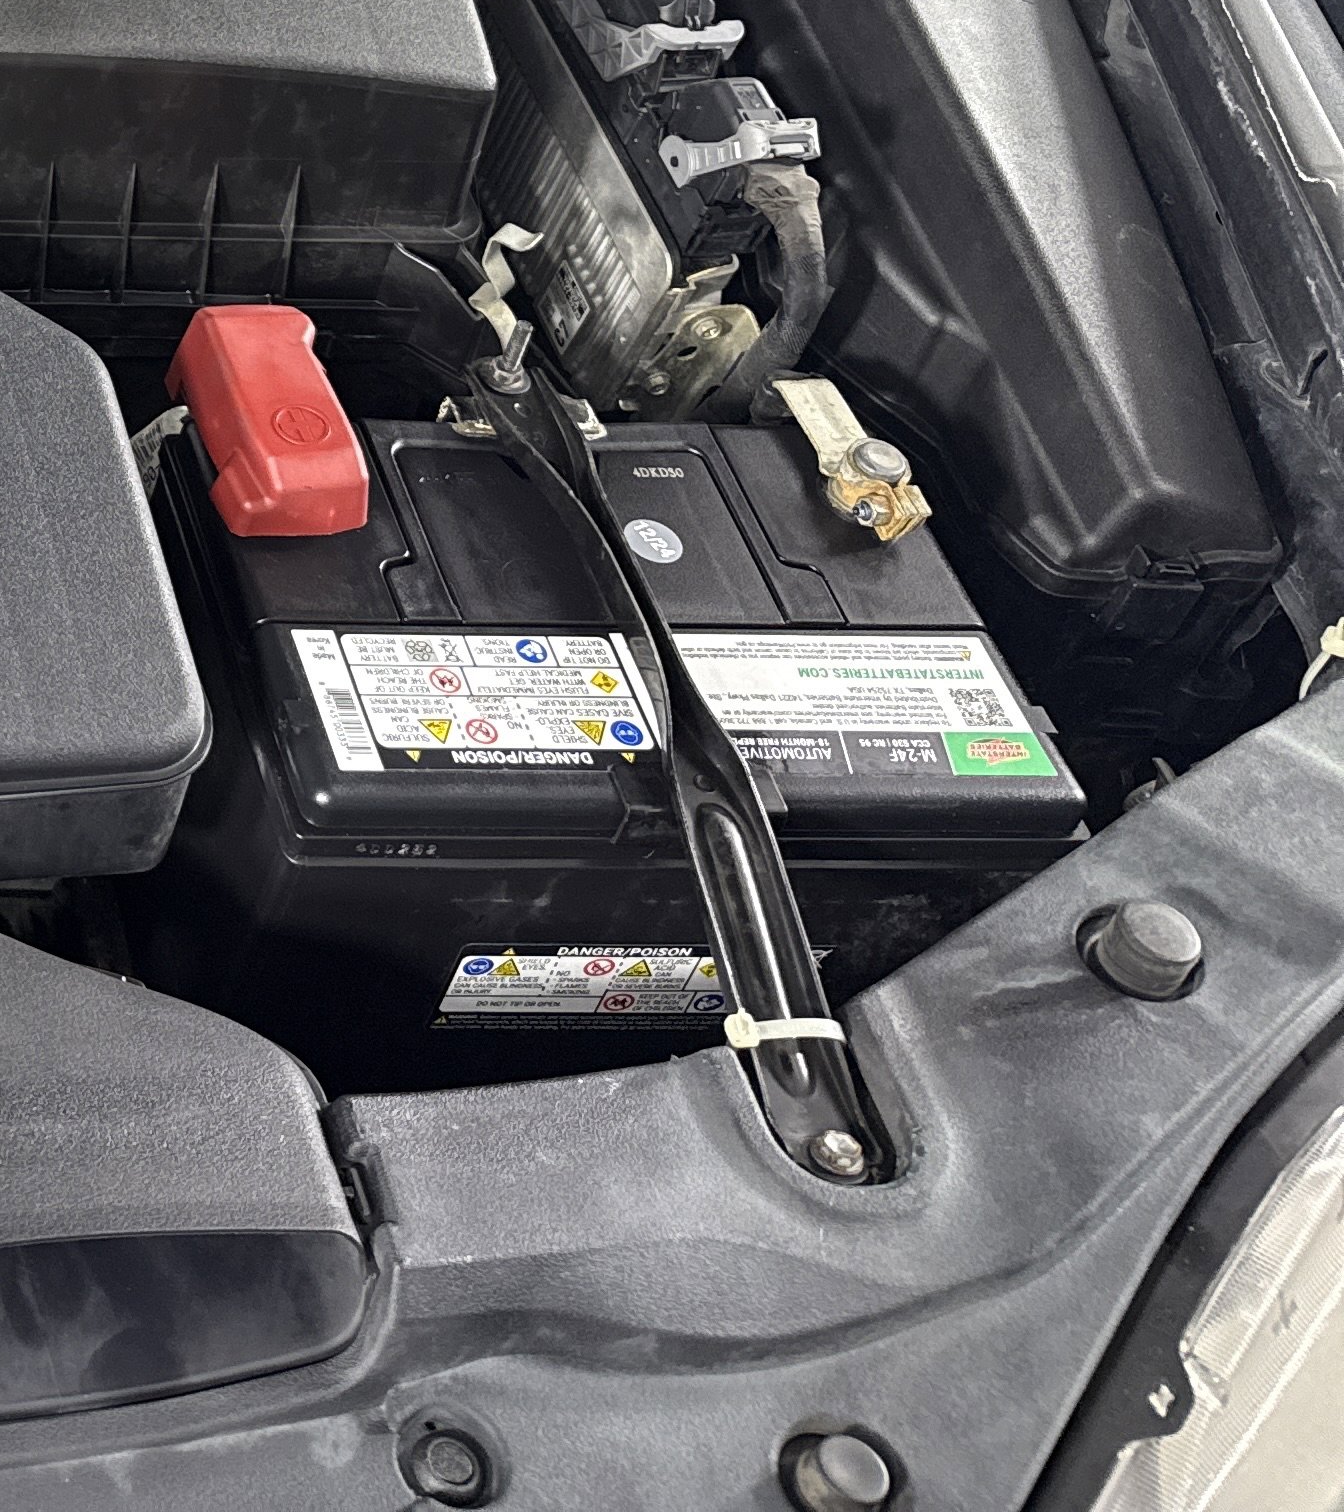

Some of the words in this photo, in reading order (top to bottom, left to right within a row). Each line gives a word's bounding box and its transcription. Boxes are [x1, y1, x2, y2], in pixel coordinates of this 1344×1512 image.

[633, 520, 676, 559] 12/24
[356, 645, 369, 653] BE
[370, 645, 395, 653] MUST
[567, 648, 592, 656] OPEN
[593, 648, 607, 656] OR
[311, 652, 336, 661] Made
[360, 654, 399, 663] BATTERY
[563, 656, 576, 664] TIP
[577, 656, 596, 664] NOT
[597, 656, 611, 664] DO
[517, 668, 542, 677] HELP
[543, 668, 583, 677] MEDICAL
[797, 667, 986, 680] INTERSTATEBATTERIES.COM
[376, 676, 408, 685] REACH
[409, 676, 428, 685] THE
[507, 677, 525, 686] GET
[560, 677, 586, 686] WITH
[388, 685, 406, 694] OUT
[408, 685, 430, 694] KEEP
[535, 686, 559, 695] EYES
[560, 686, 590, 695] FLUSH
[422, 707, 450, 715] CAUSE
[474, 704, 510, 712] FLAMES
[525, 707, 554, 716] CAUSE
[555, 708, 575, 716] CAN
[576, 708, 610, 717] GASES
[390, 716, 410, 724] CAN
[396, 724, 420, 733] ACID
[506, 721, 522, 729] NO
[381, 733, 431, 743] SULFURIC
[552, 734, 589, 744] SHIELD
[755, 737, 780, 746] FREE
[780, 737, 831, 747] 18-MONTH
[910, 738, 931, 747] CCA
[969, 743, 1022, 751] BATTERIES
[451, 750, 595, 765] DANGER/POISON
[737, 746, 833, 760] AUTOMOTIVE
[888, 747, 938, 763] M-24F
[969, 750, 1028, 759] INTERSTATE
[556, 946, 693, 957] DANGER/POISON
[649, 958, 694, 966] SULFURIC
